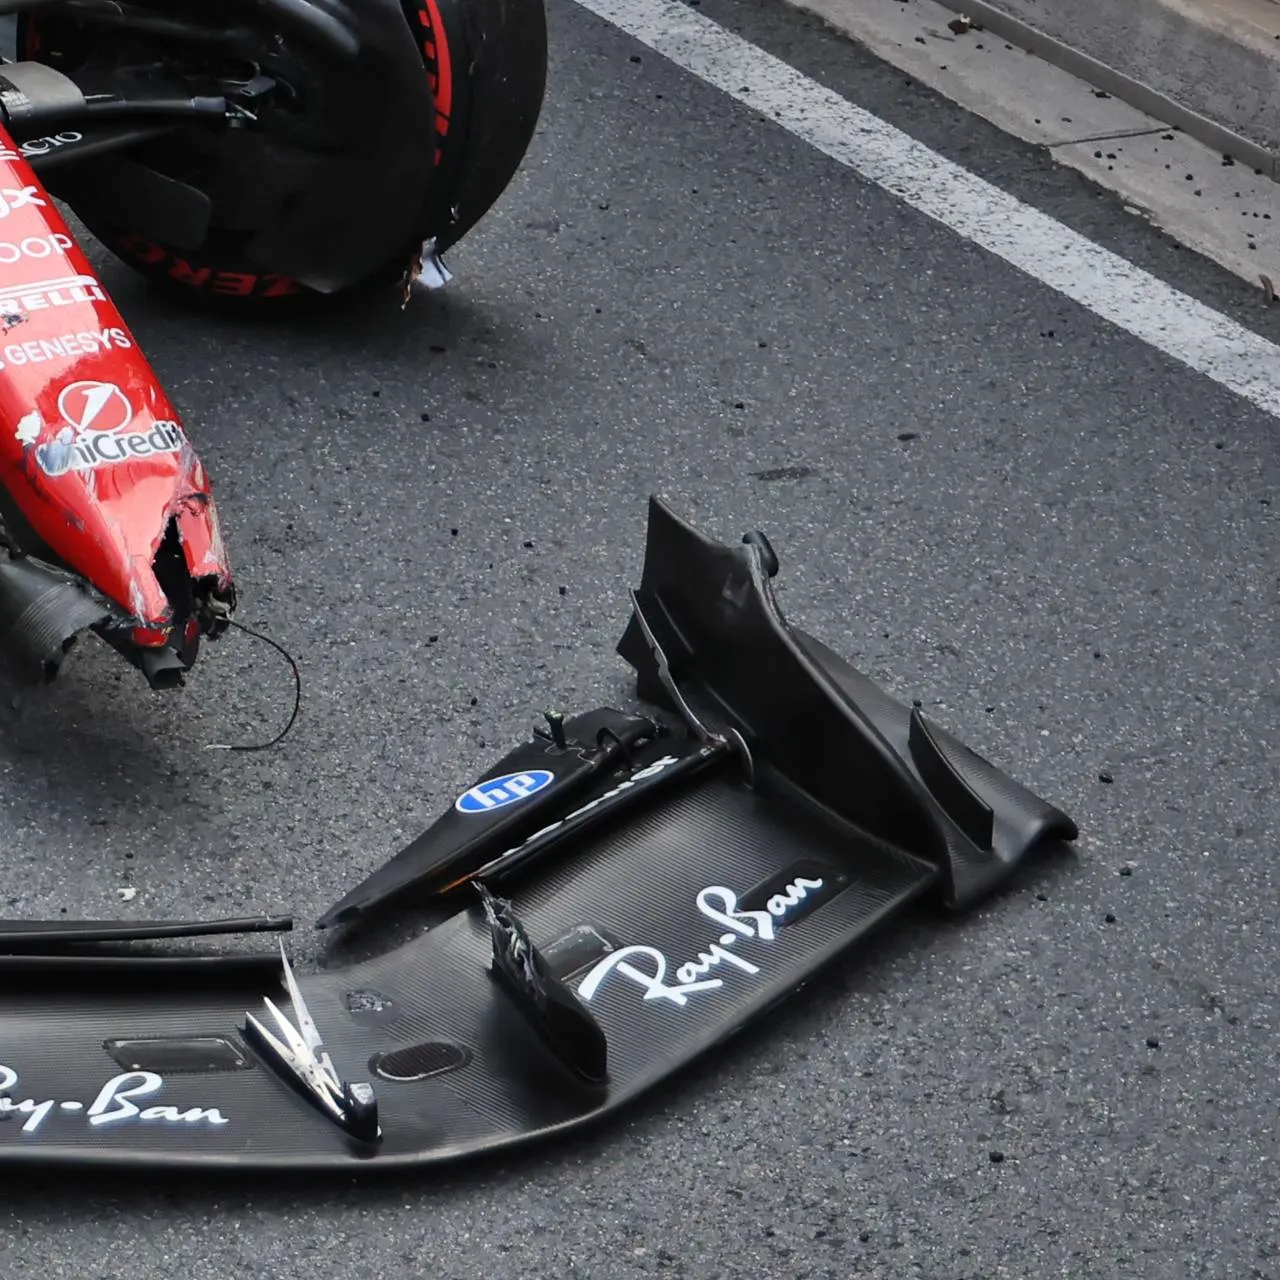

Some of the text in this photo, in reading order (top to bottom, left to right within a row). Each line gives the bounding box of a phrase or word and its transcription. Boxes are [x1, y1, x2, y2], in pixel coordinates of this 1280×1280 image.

[3, 328, 132, 366] GENESYS
[460, 771, 548, 812] hp
[581, 871, 825, 1008] Ray-Ban
